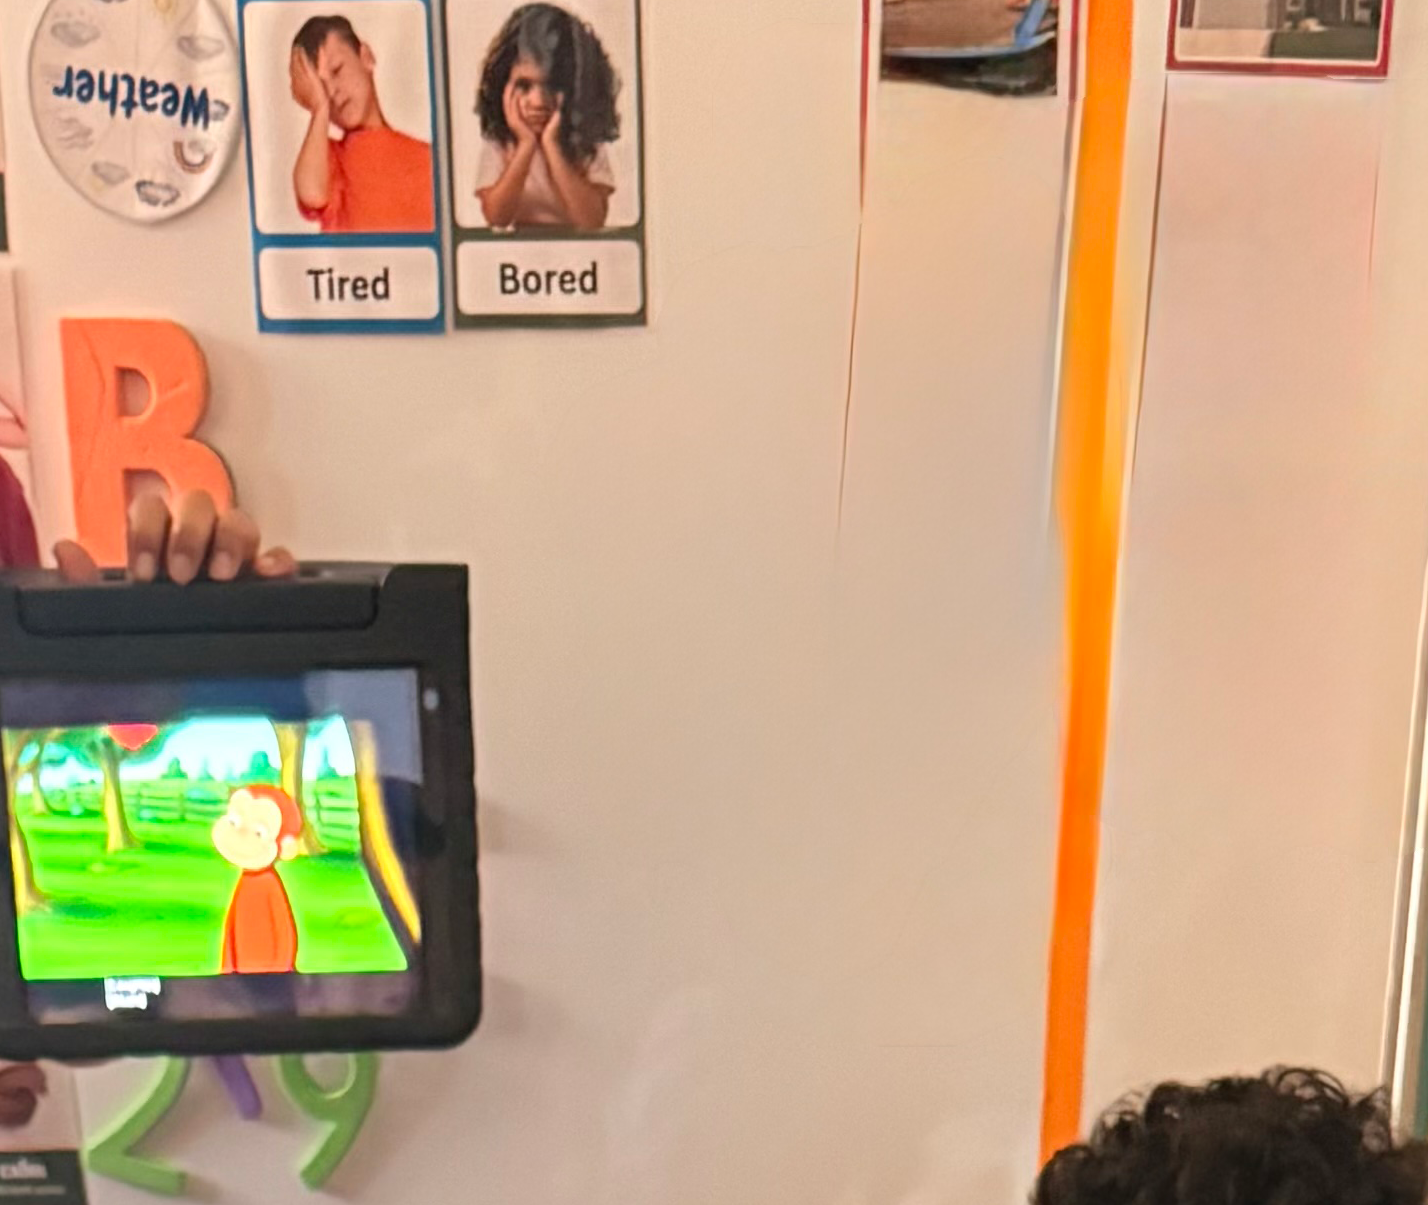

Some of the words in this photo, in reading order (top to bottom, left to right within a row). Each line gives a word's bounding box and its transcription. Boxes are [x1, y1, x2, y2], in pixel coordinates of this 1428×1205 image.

[52, 65, 210, 131] Weather
[306, 268, 390, 302] Tired
[498, 261, 598, 295] Bored
